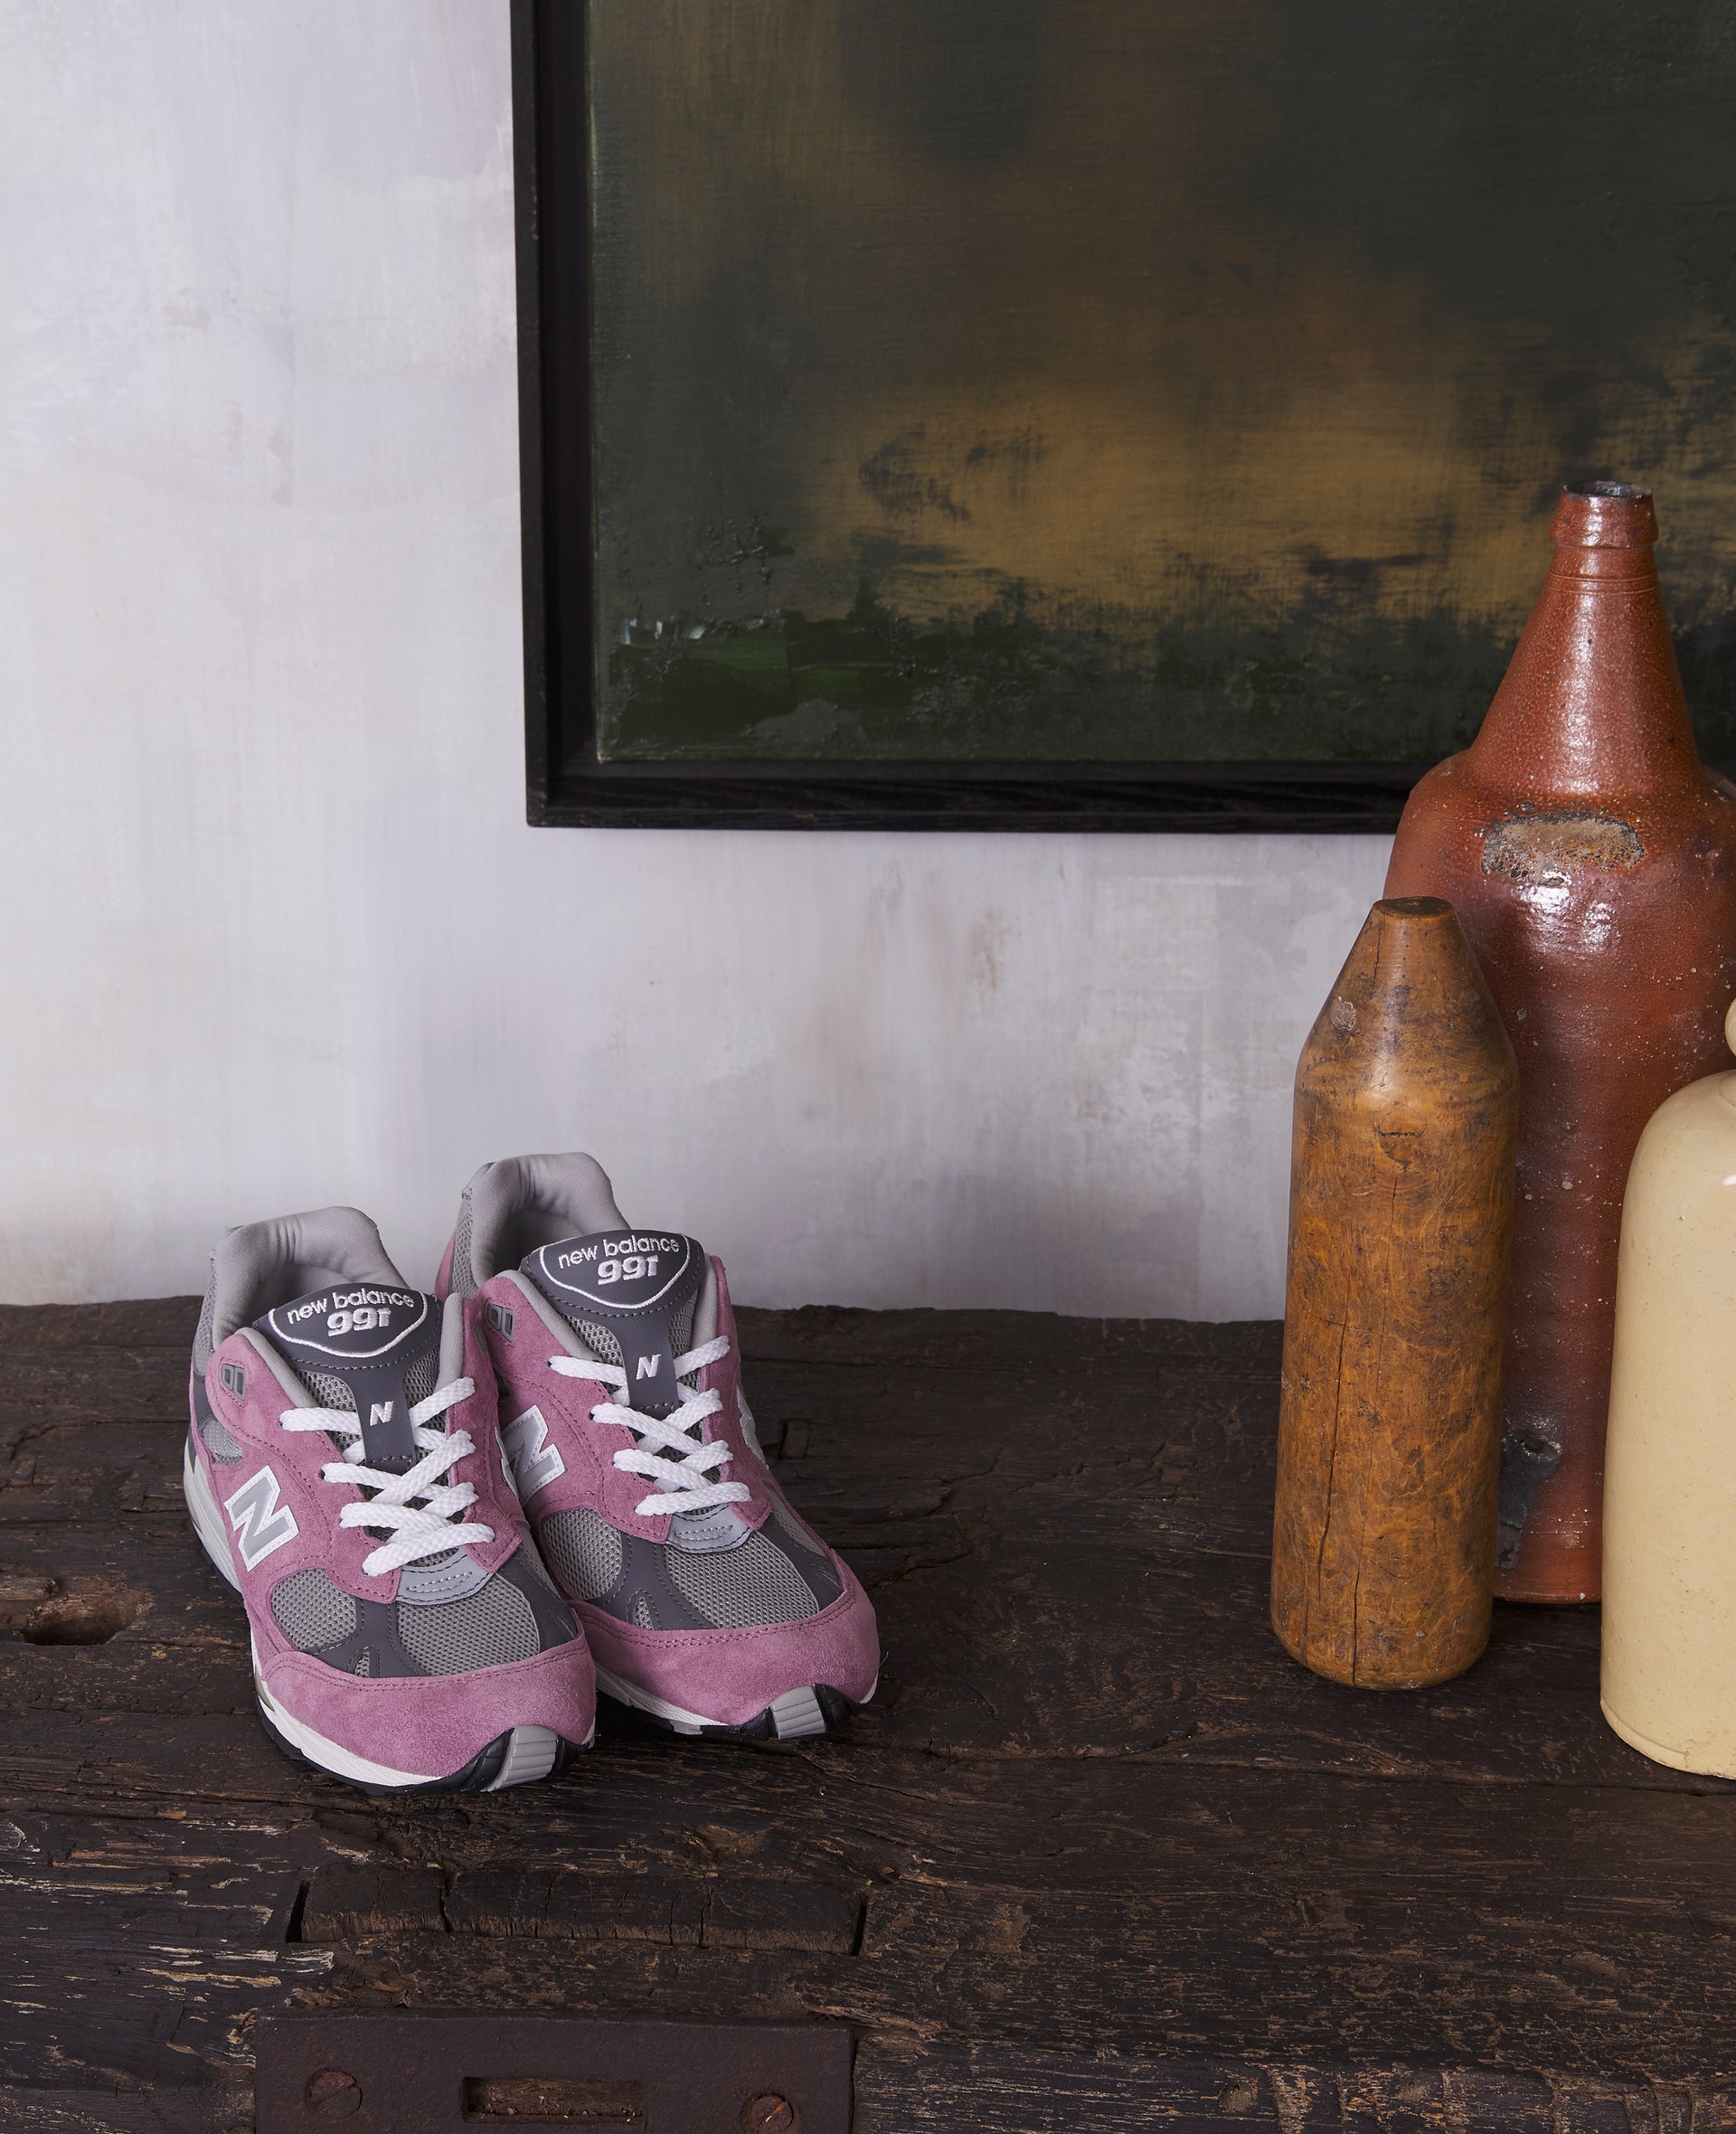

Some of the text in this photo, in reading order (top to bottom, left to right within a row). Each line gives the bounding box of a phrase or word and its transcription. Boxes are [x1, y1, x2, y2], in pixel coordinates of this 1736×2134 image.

[558, 1234, 680, 1270] new balance
[597, 1254, 659, 1286] 991
[287, 1288, 415, 1325] new balance
[326, 1307, 392, 1337] 991
[636, 1354, 662, 1381] N
[369, 1401, 395, 1427] N
[500, 1404, 566, 1506] N
[223, 1464, 300, 1572] N
